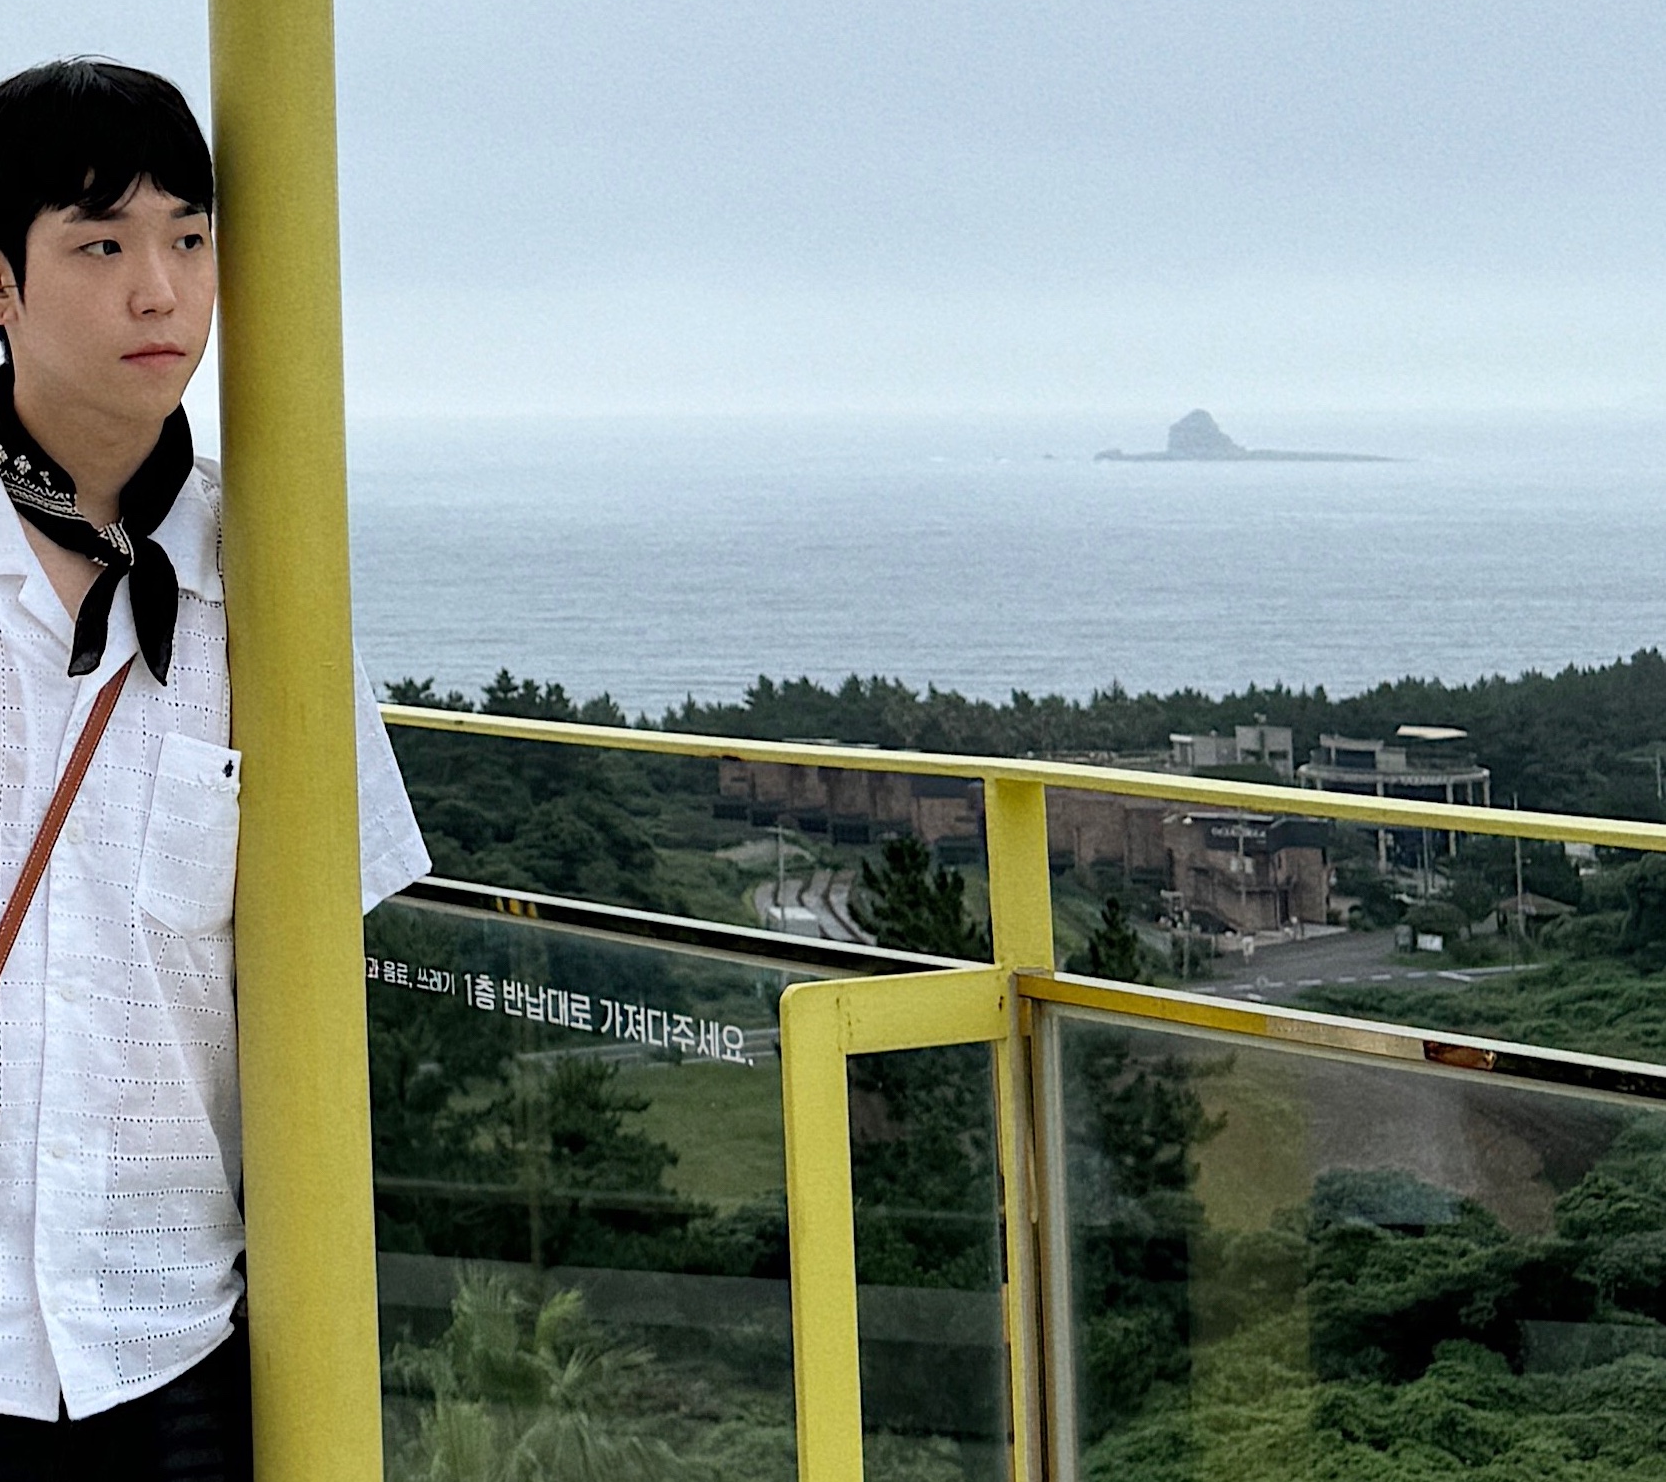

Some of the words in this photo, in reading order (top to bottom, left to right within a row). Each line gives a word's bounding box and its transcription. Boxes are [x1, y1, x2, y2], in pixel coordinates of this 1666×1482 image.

[383, 960, 413, 989] 음료,
[416, 966, 456, 996] 쓰레기
[463, 972, 497, 1011] 1층
[502, 979, 594, 1033] 반납대로
[599, 998, 754, 1067] 가져다주세요.
